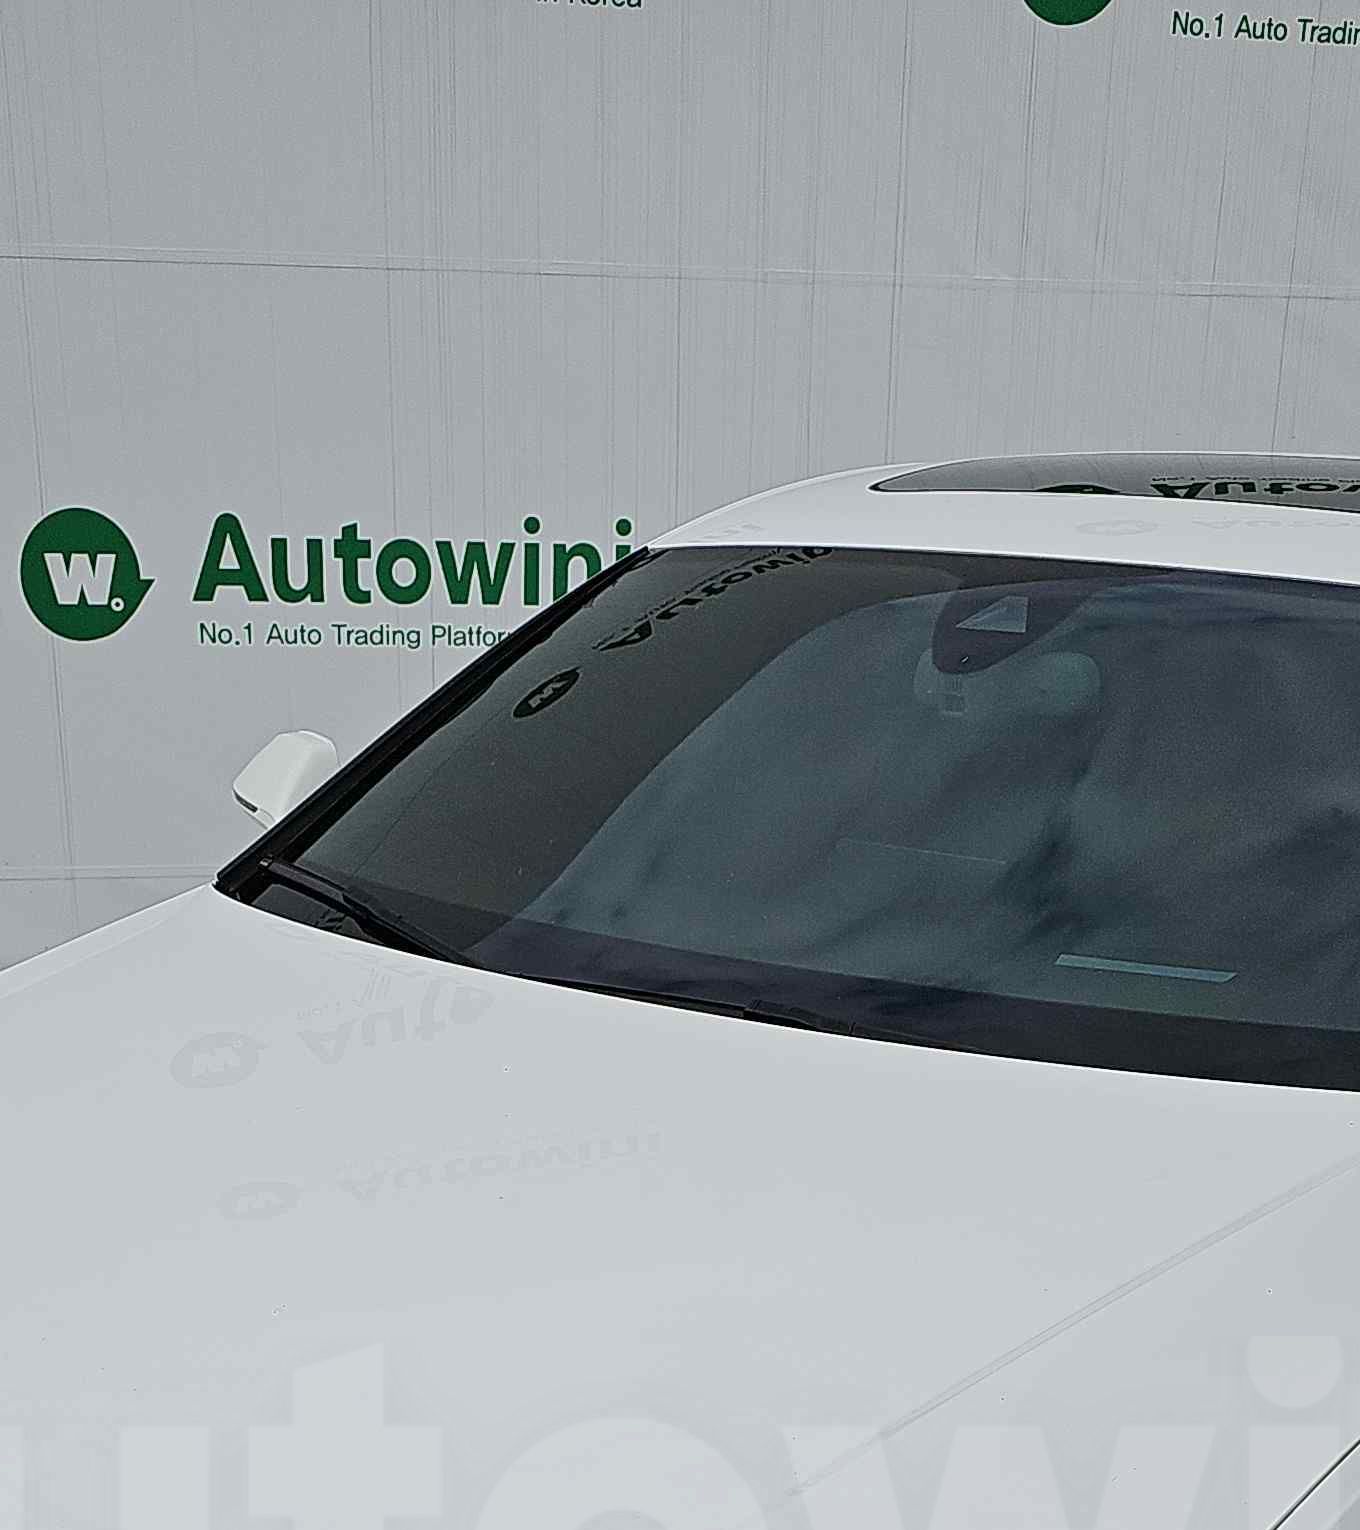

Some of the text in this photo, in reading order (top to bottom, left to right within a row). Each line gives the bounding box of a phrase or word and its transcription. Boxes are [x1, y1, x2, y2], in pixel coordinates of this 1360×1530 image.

[1171, 10, 1224, 39] No.1
[1234, 14, 1288, 42] Auto
[199, 622, 511, 650] No.1 Auto Trading Platfor
